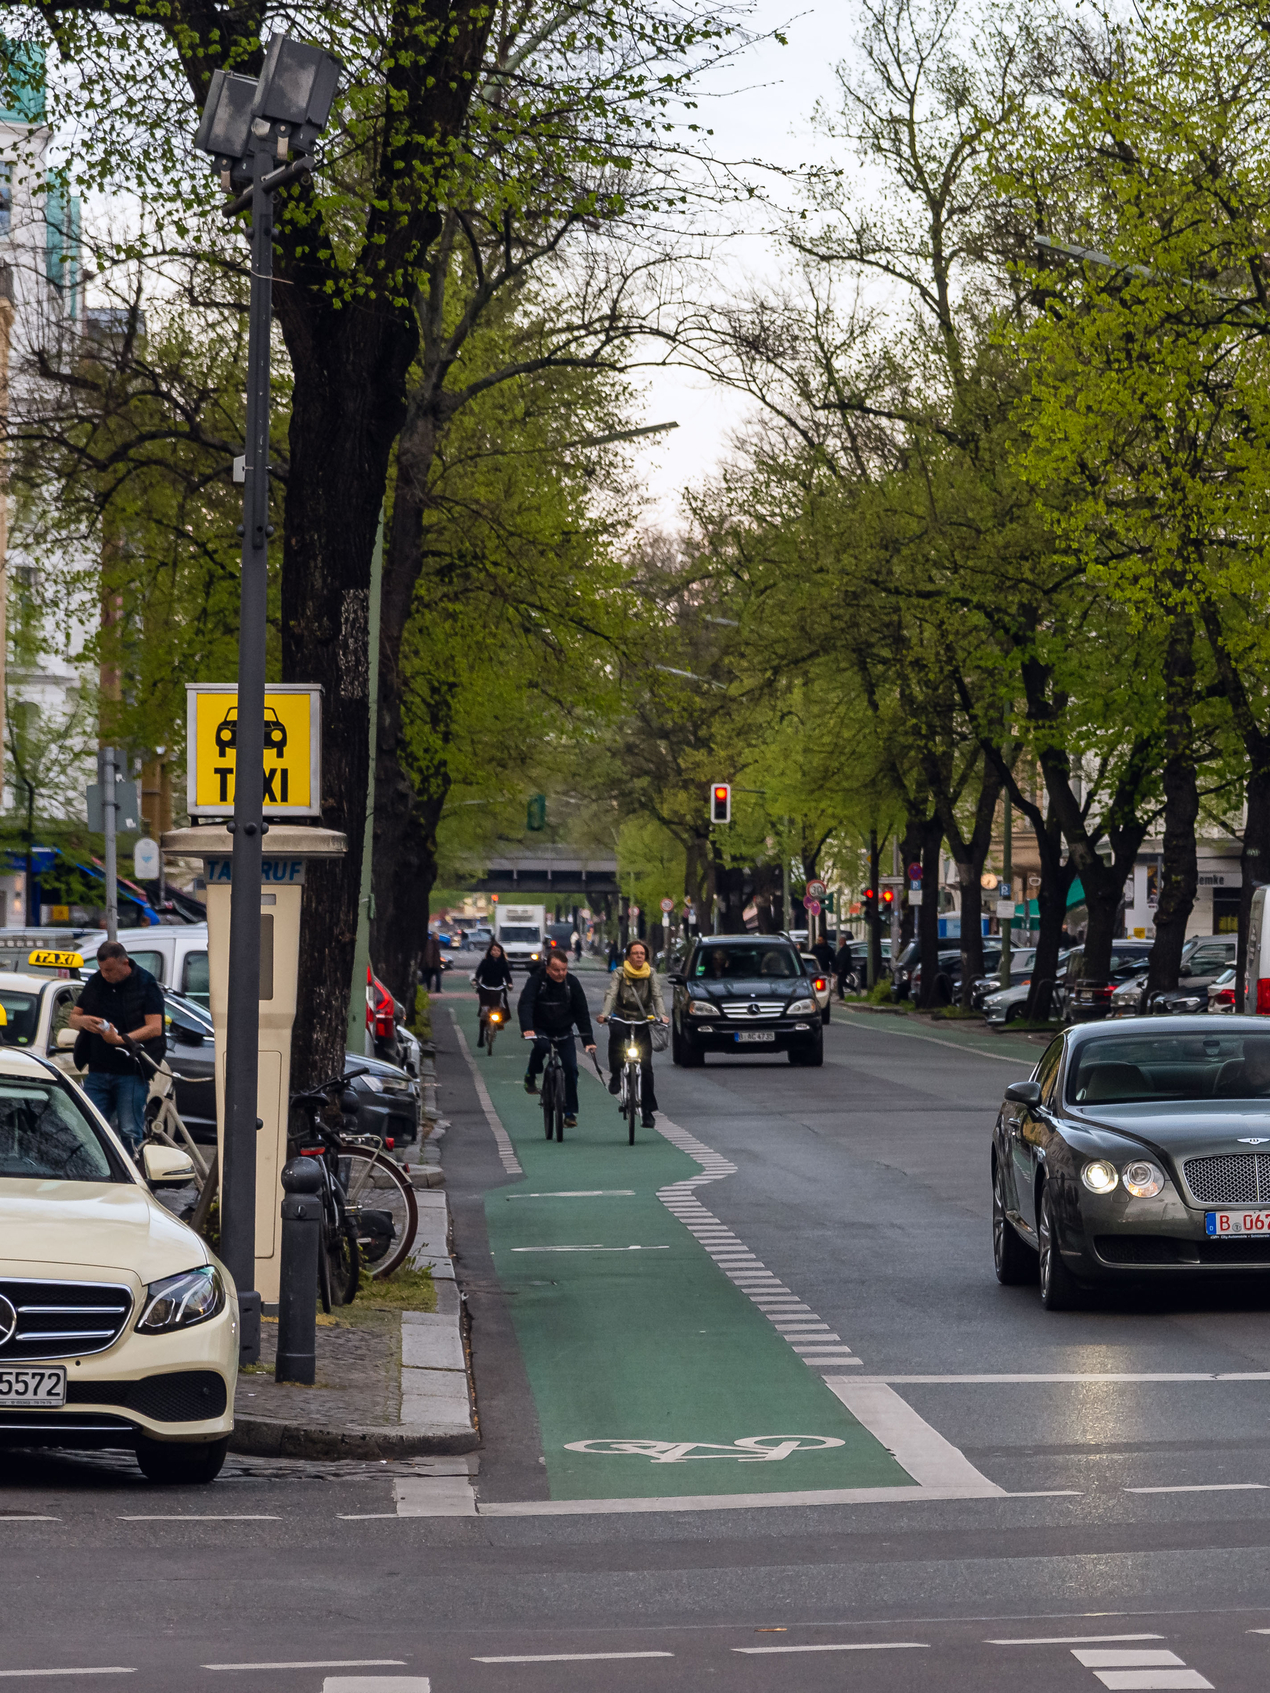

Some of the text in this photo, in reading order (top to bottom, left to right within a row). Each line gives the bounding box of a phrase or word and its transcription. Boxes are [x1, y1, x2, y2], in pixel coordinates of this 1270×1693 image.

[214, 768, 289, 803] TXI
[35, 953, 75, 965] TAXI
[1219, 1215, 1231, 1231] B
[0, 1372, 61, 1397] 5572
